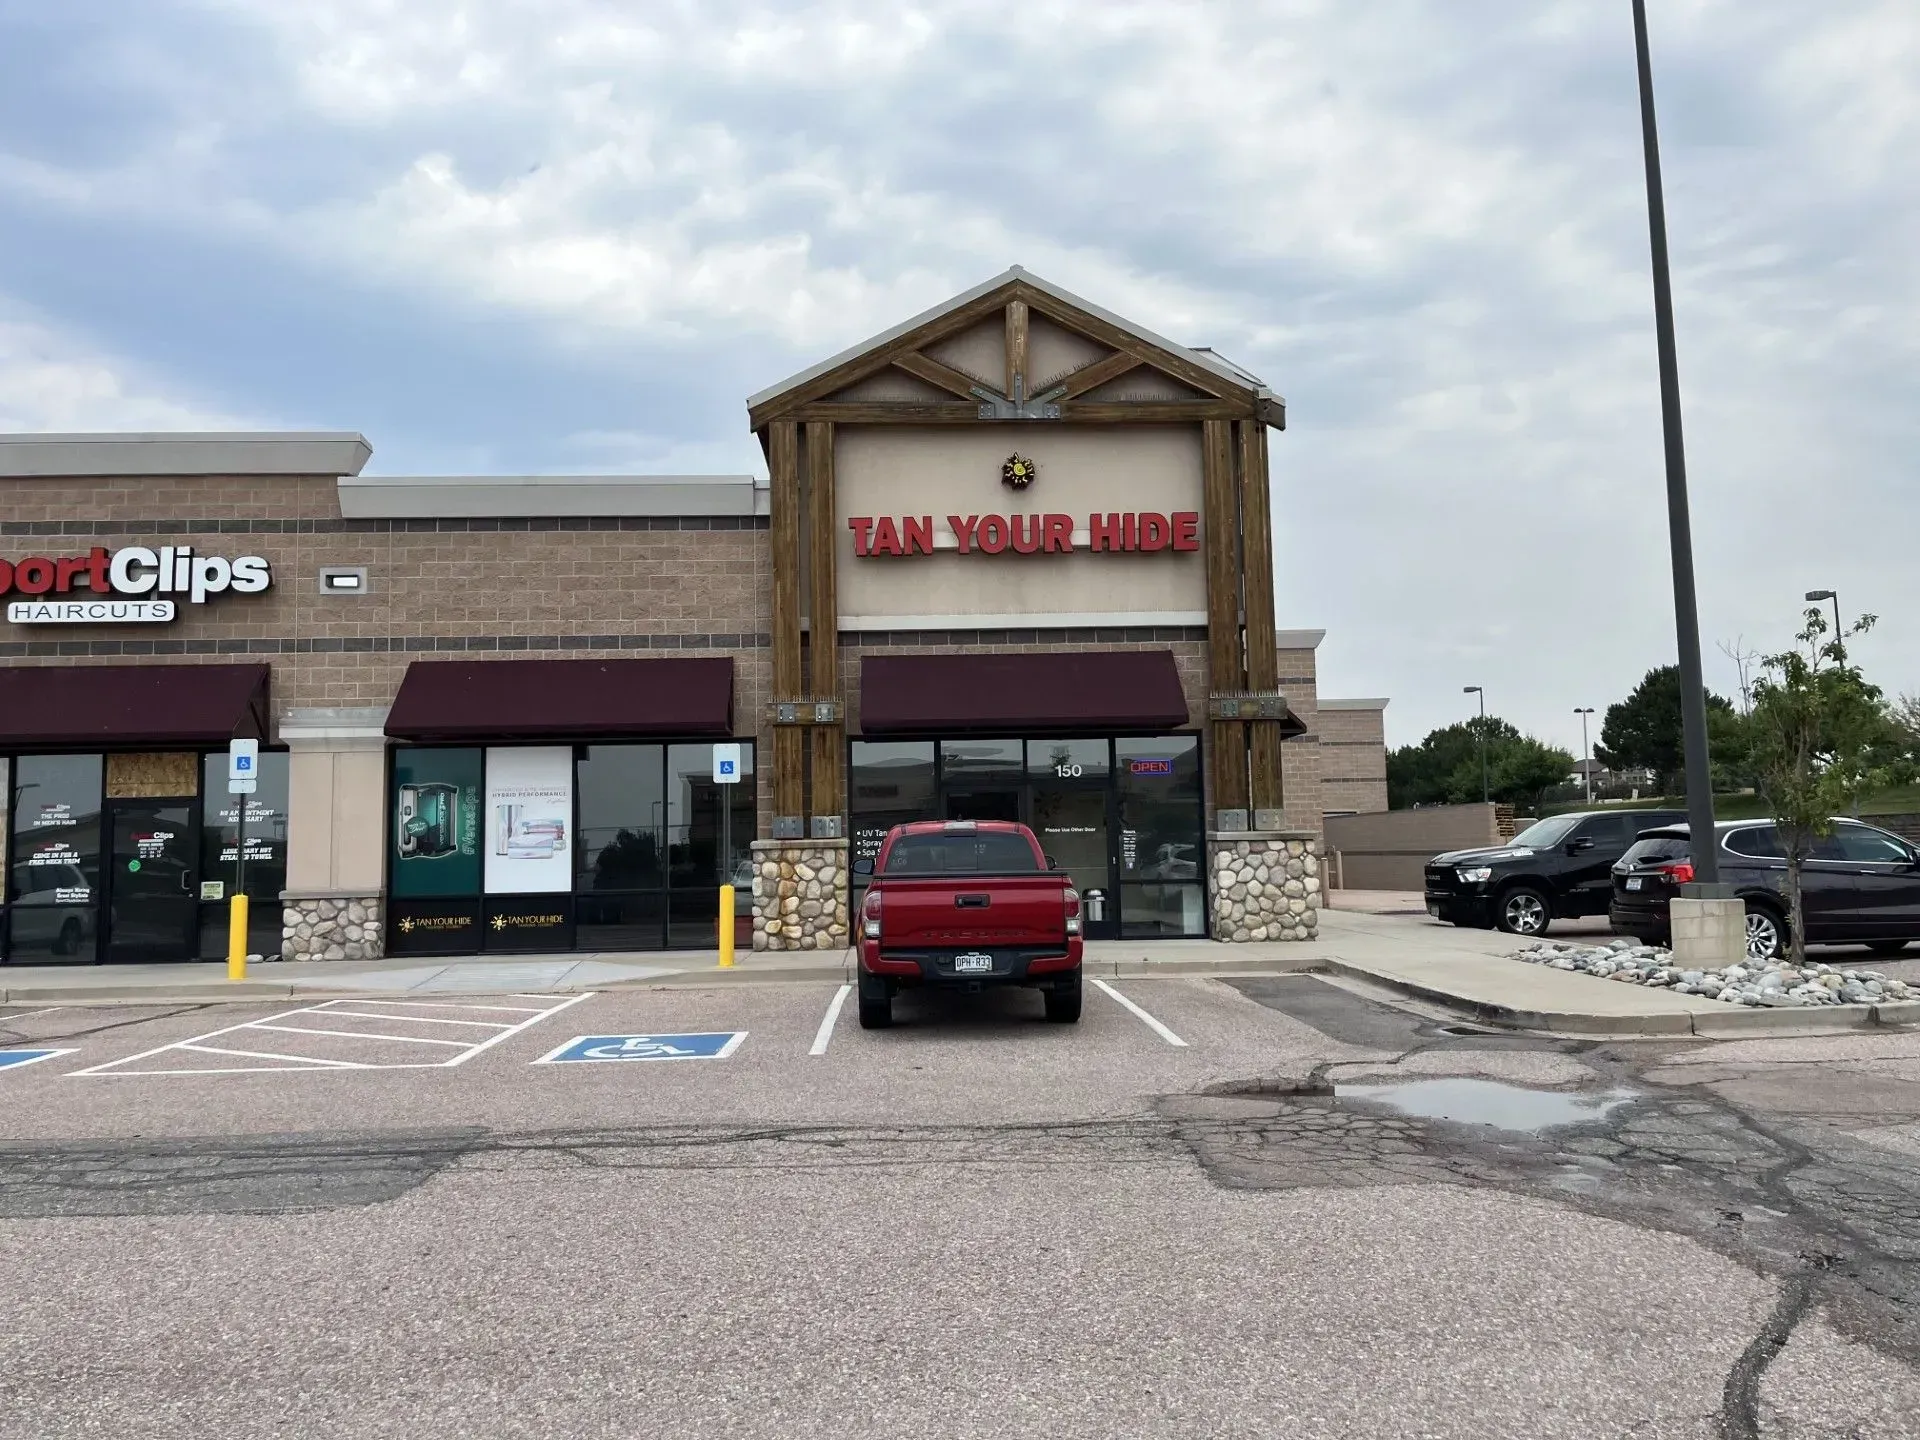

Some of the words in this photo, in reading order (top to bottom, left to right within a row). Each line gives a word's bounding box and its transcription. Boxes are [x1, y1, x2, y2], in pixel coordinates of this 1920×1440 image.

[848, 515, 933, 557] TAN
[947, 513, 1075, 555] YOUR
[1089, 511, 1200, 553] HIDE
[13, 603, 169, 620] HAIRCUTS
[1055, 764, 1082, 777] 150
[1131, 762, 1168, 772] OPEN
[153, 831, 175, 840] Clips
[862, 840, 883, 848] Spray
[416, 918, 432, 926] TAN
[433, 917, 454, 925] YOUR
[454, 916, 472, 925] HIDE
[508, 916, 524, 924] TAN
[524, 915, 546, 924] YOUR
